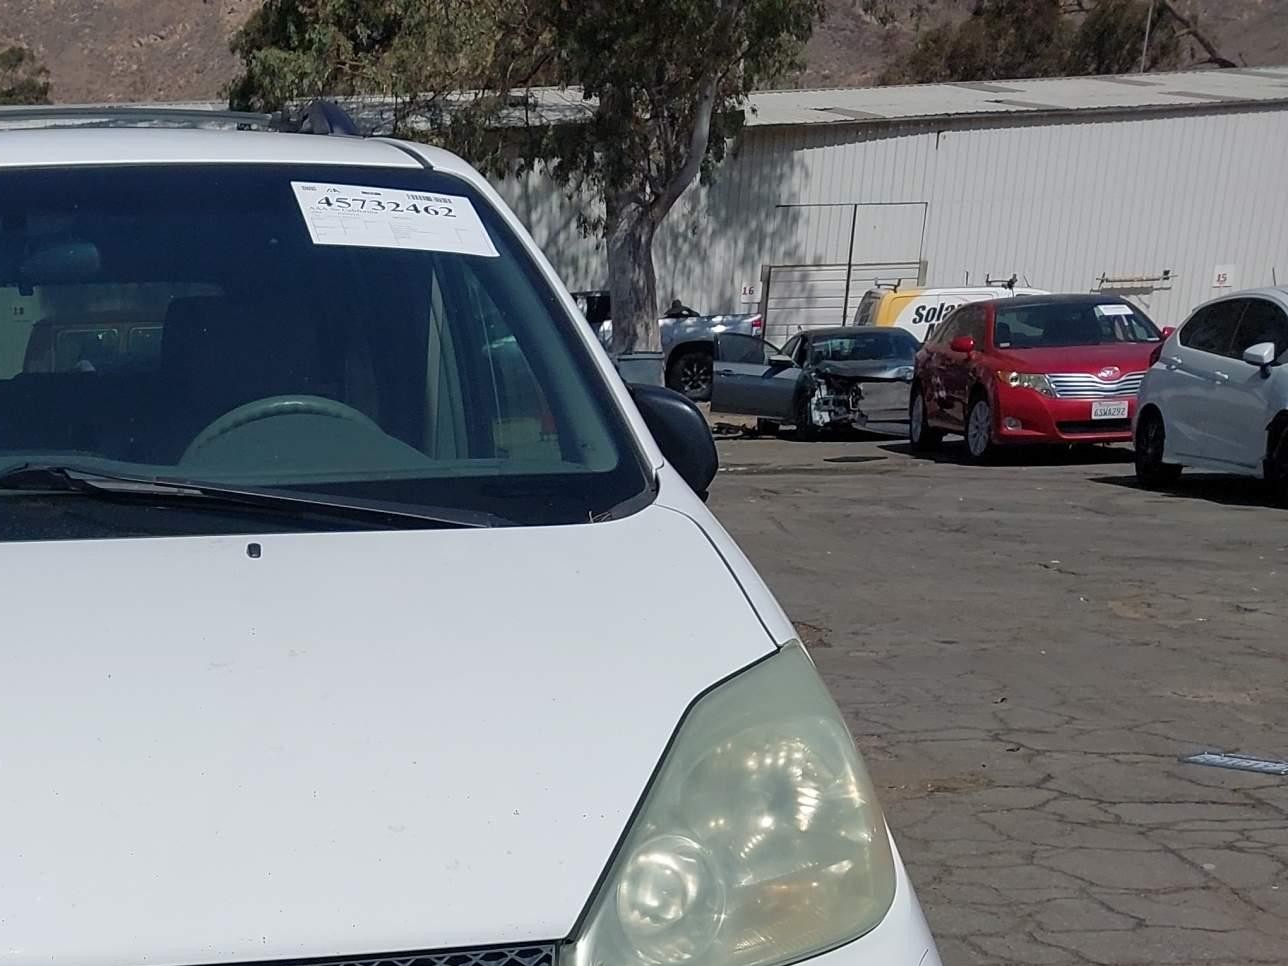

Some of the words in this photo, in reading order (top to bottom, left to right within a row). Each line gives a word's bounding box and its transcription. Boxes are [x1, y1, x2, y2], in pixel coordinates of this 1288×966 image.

[317, 196, 457, 218] 45732462
[1216, 273, 1228, 283] 15
[742, 286, 755, 296] 16
